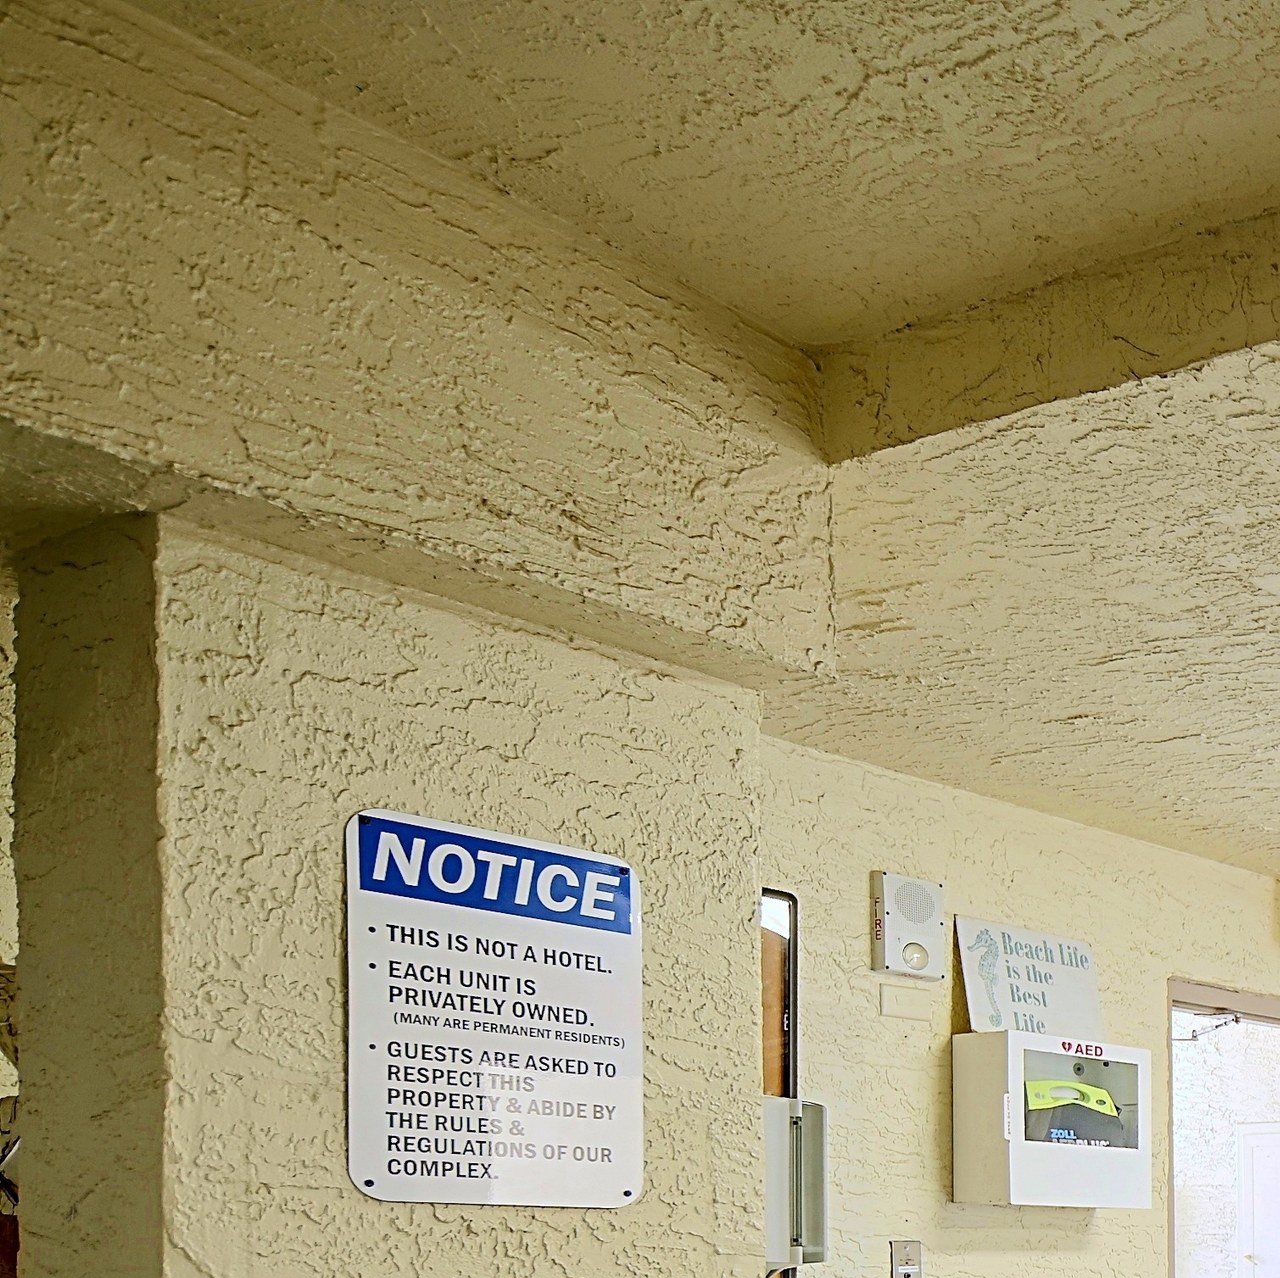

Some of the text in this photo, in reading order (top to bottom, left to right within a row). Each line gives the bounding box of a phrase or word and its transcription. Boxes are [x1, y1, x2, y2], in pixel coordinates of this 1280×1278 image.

[372, 832, 620, 921] NOTICE
[874, 897, 882, 941] FIRE
[386, 924, 613, 974] THIS IS NOT A HOTEL.
[1000, 931, 1090, 970] Beach Life
[389, 960, 536, 996] EACH UNIT IS
[1005, 959, 1054, 986] is the
[389, 985, 595, 1027] PRIVATELY OWNED.
[1009, 983, 1048, 1008] Best
[393, 1012, 626, 1049] (MANY ARE PERMANENT RESIDENTS)
[1013, 1011, 1047, 1034] Life
[387, 1041, 617, 1078] GUESTS ARE ASKED TO
[1075, 1043, 1103, 1057] AED
[387, 1065, 535, 1093] RESPECT THIS
[387, 1088, 617, 1121] PROPERTY & ABIDE BY
[385, 1111, 525, 1137] THE RULES &
[1050, 1128, 1077, 1139] ZOLL
[387, 1135, 612, 1163] REGULATIONS OF OUR
[387, 1159, 499, 1180] COMPLEX.
